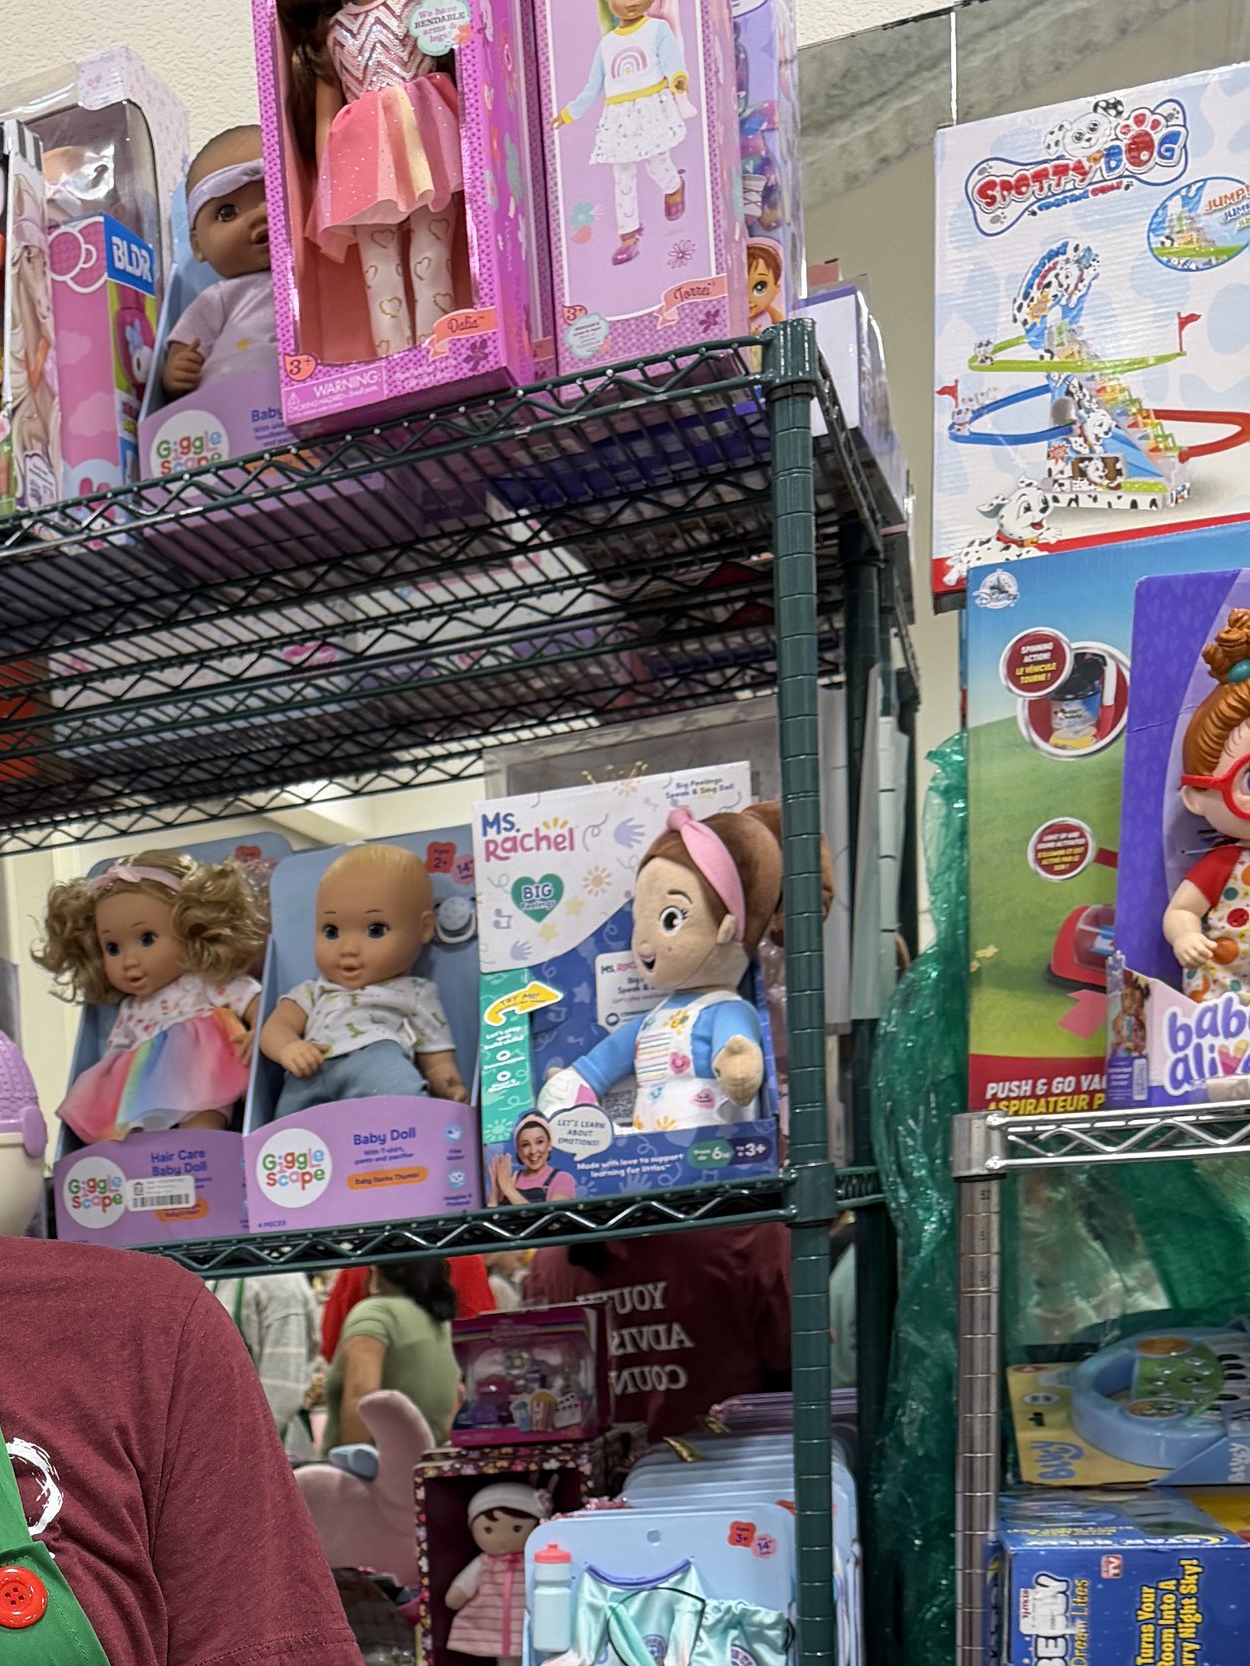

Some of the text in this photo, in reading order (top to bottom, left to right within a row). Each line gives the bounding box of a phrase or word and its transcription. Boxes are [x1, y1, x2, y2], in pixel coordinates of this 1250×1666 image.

[975, 158, 1094, 209] SPOTTY
[1102, 118, 1183, 175] DOG
[111, 235, 153, 283] BLDR
[288, 358, 312, 375] 3+
[313, 370, 382, 398] WARNING:
[156, 430, 223, 462] Giggle
[481, 812, 521, 837] MS.
[484, 826, 575, 863] Rachel
[522, 883, 553, 900] BIG
[1167, 995, 1250, 1054] bab
[985, 1081, 1032, 1099] PUSH
[1035, 1079, 1048, 1093] &
[1051, 1076, 1076, 1093] GO
[353, 1127, 417, 1147] Baby Doll
[151, 1149, 206, 1163] Hair Care
[262, 1147, 325, 1175] Giggle
[576, 1161, 600, 1170] Made
[601, 1158, 619, 1168] with
[620, 1157, 638, 1167] love
[650, 1153, 685, 1166] support
[152, 1161, 207, 1178] Baby Doll
[265, 1167, 326, 1191] scape
[590, 1168, 626, 1179] learning
[68, 1175, 123, 1197] Giggle
[71, 1191, 124, 1214] scape
[1030, 1440, 1084, 1481] Bluey
[1157, 1580, 1176, 1592] A
[1179, 1558, 1201, 1595] Sky!
[1070, 1578, 1090, 1616] Lites
[1158, 1594, 1176, 1626] Into
[1136, 1586, 1156, 1666] Turns Your
[1179, 1597, 1200, 1639] Night
